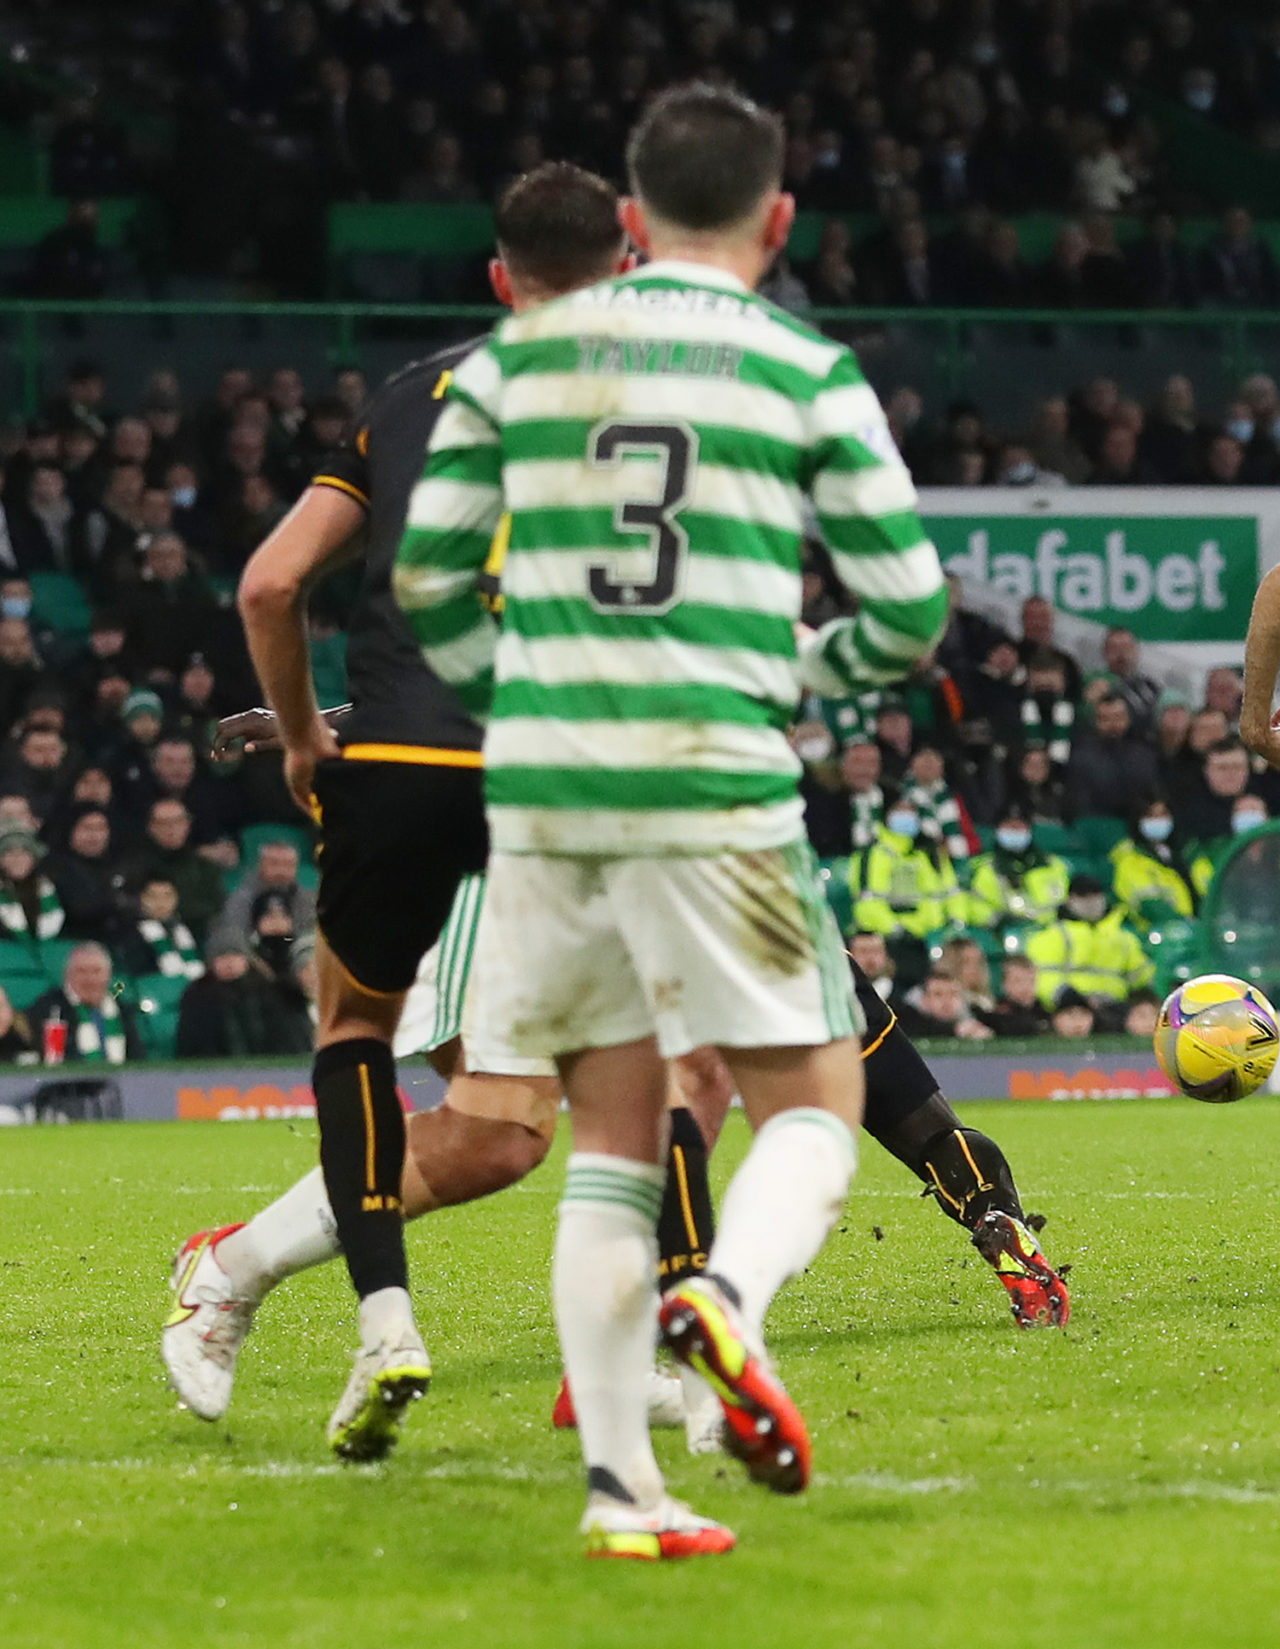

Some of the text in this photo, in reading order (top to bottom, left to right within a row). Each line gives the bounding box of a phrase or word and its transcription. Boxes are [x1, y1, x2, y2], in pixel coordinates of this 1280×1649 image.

[578, 334, 742, 382] TAYLOR
[584, 417, 699, 616] 3
[940, 529, 1227, 612] dafabet
